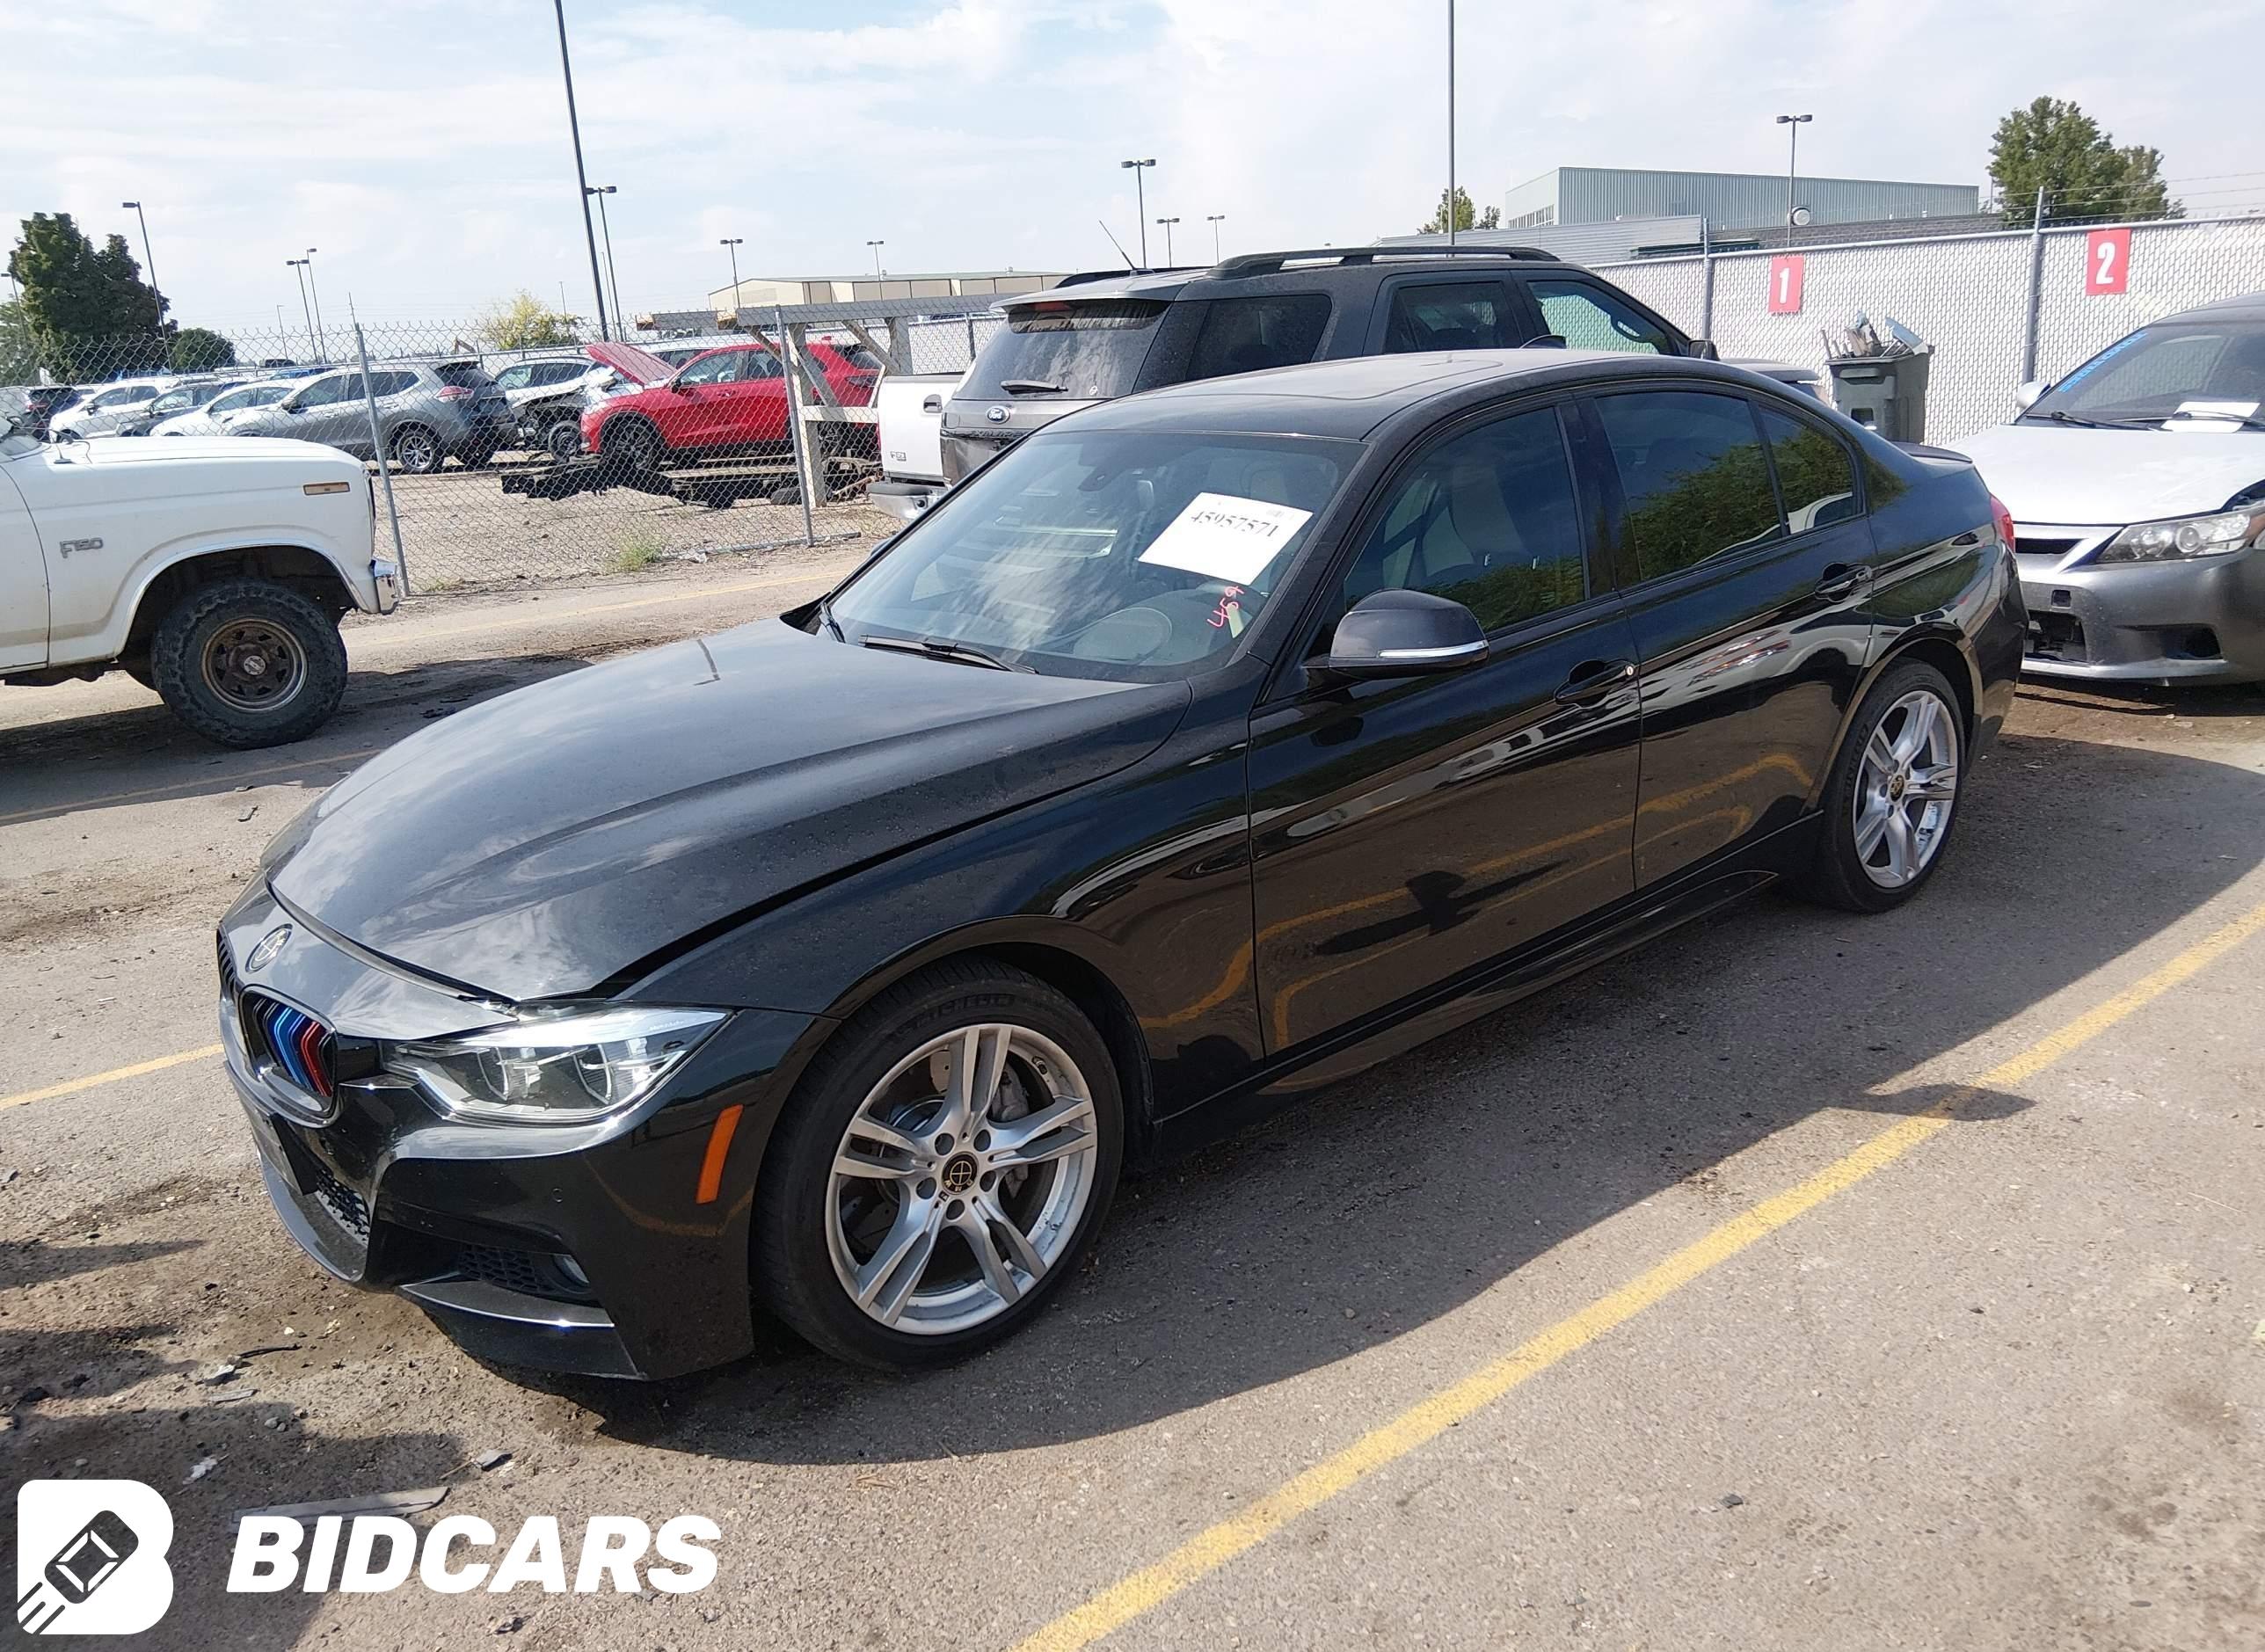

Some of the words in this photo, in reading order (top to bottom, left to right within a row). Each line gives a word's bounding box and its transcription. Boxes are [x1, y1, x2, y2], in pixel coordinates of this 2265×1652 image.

[2095, 241, 2116, 285] 2
[1779, 266, 1790, 304] 1
[1191, 511, 1279, 537] 45957571
